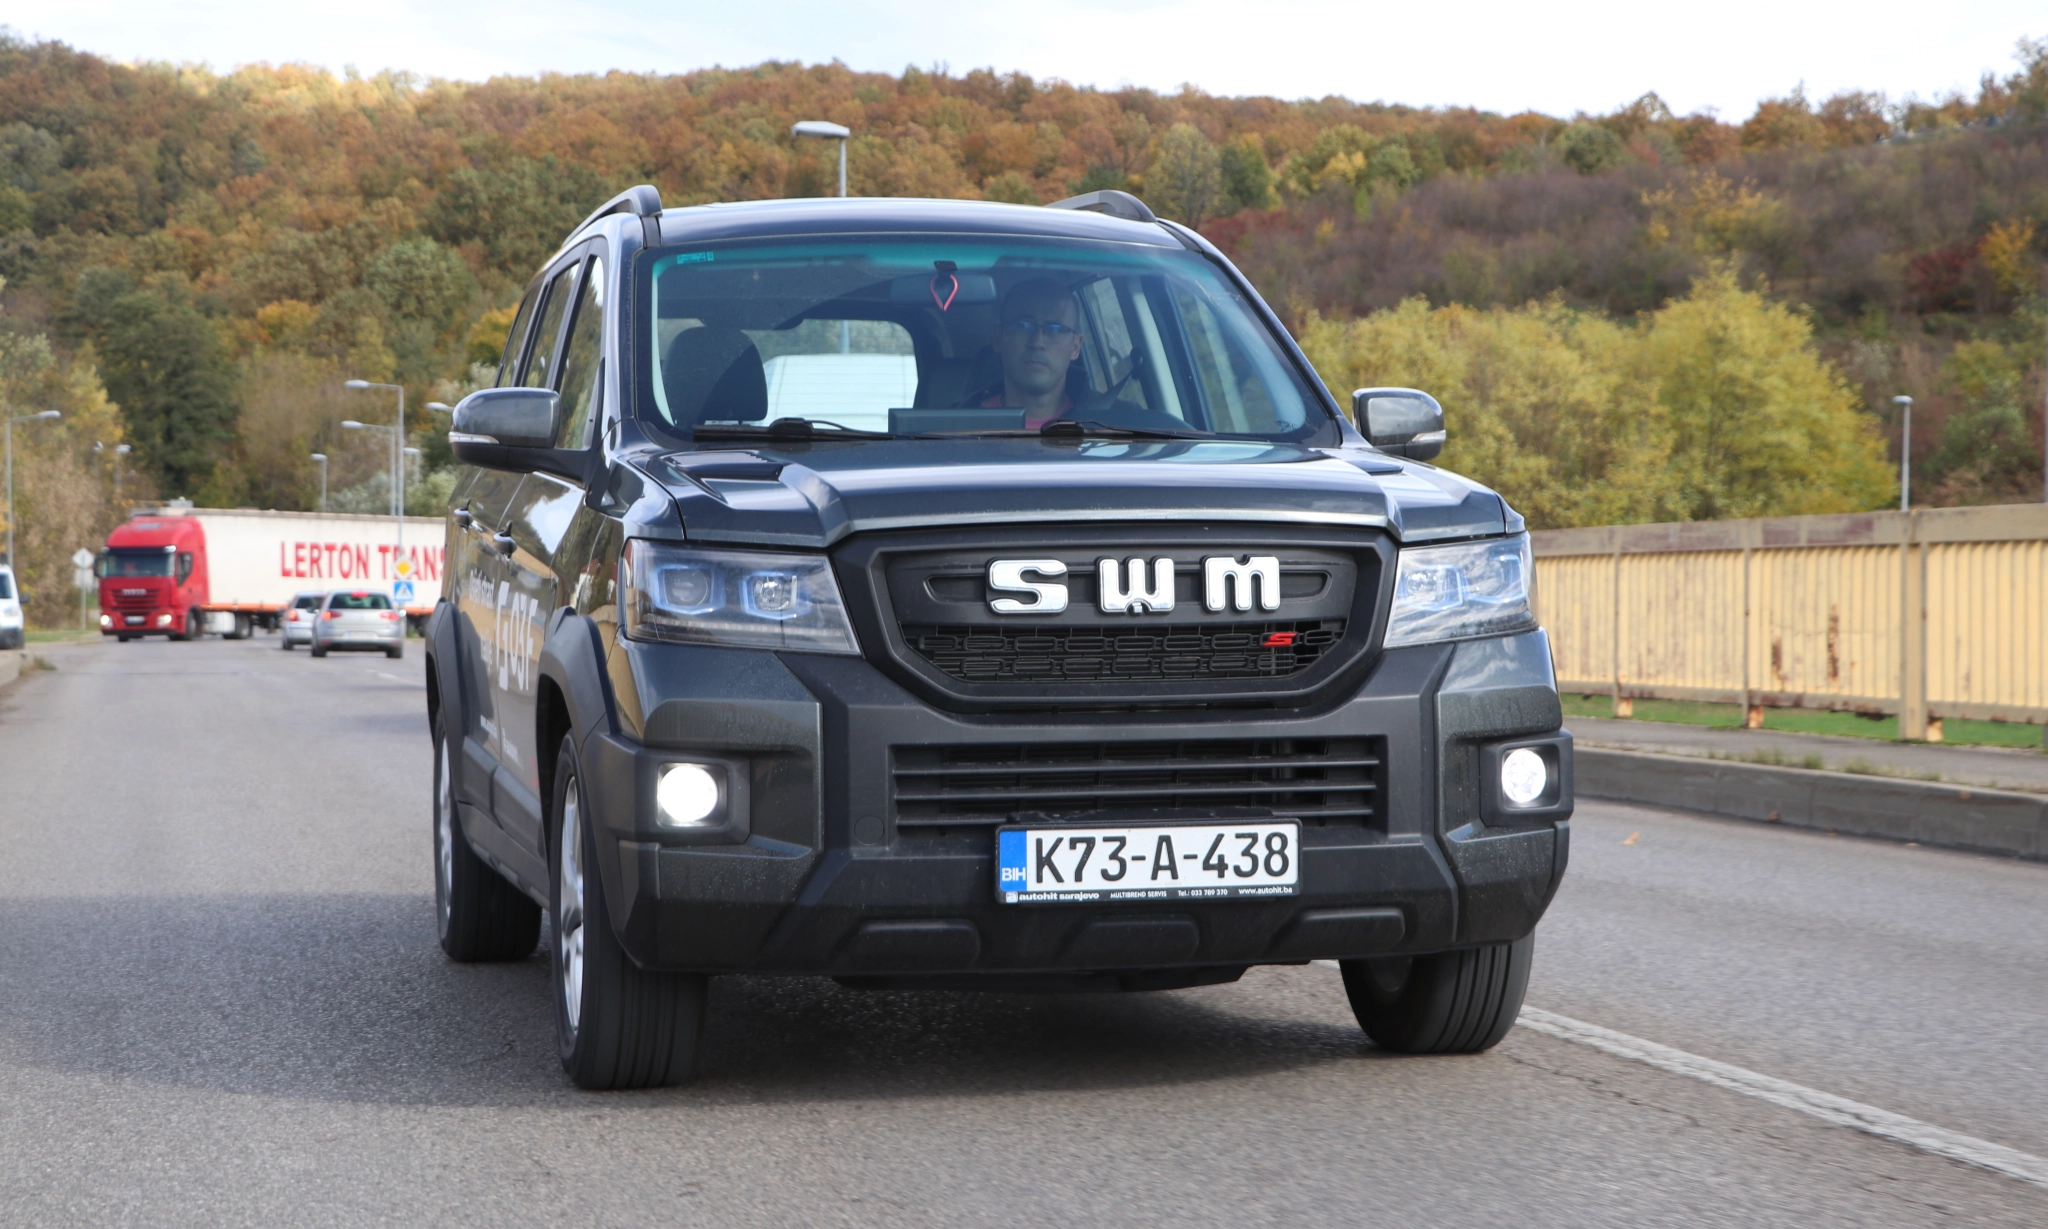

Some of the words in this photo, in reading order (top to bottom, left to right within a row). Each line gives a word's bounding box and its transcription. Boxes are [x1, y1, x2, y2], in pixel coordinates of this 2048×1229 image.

[281, 541, 369, 579] LERTON
[986, 556, 1280, 615] SWM
[1035, 832, 1290, 884] K73-A-438
[1001, 867, 1026, 882] BIH
[1019, 892, 1057, 901] autohit
[1059, 891, 1100, 901] sarajevo
[1148, 889, 1167, 898] SERVIS
[1191, 889, 1203, 897] 033
[1238, 886, 1293, 895] www.autohit.ba
